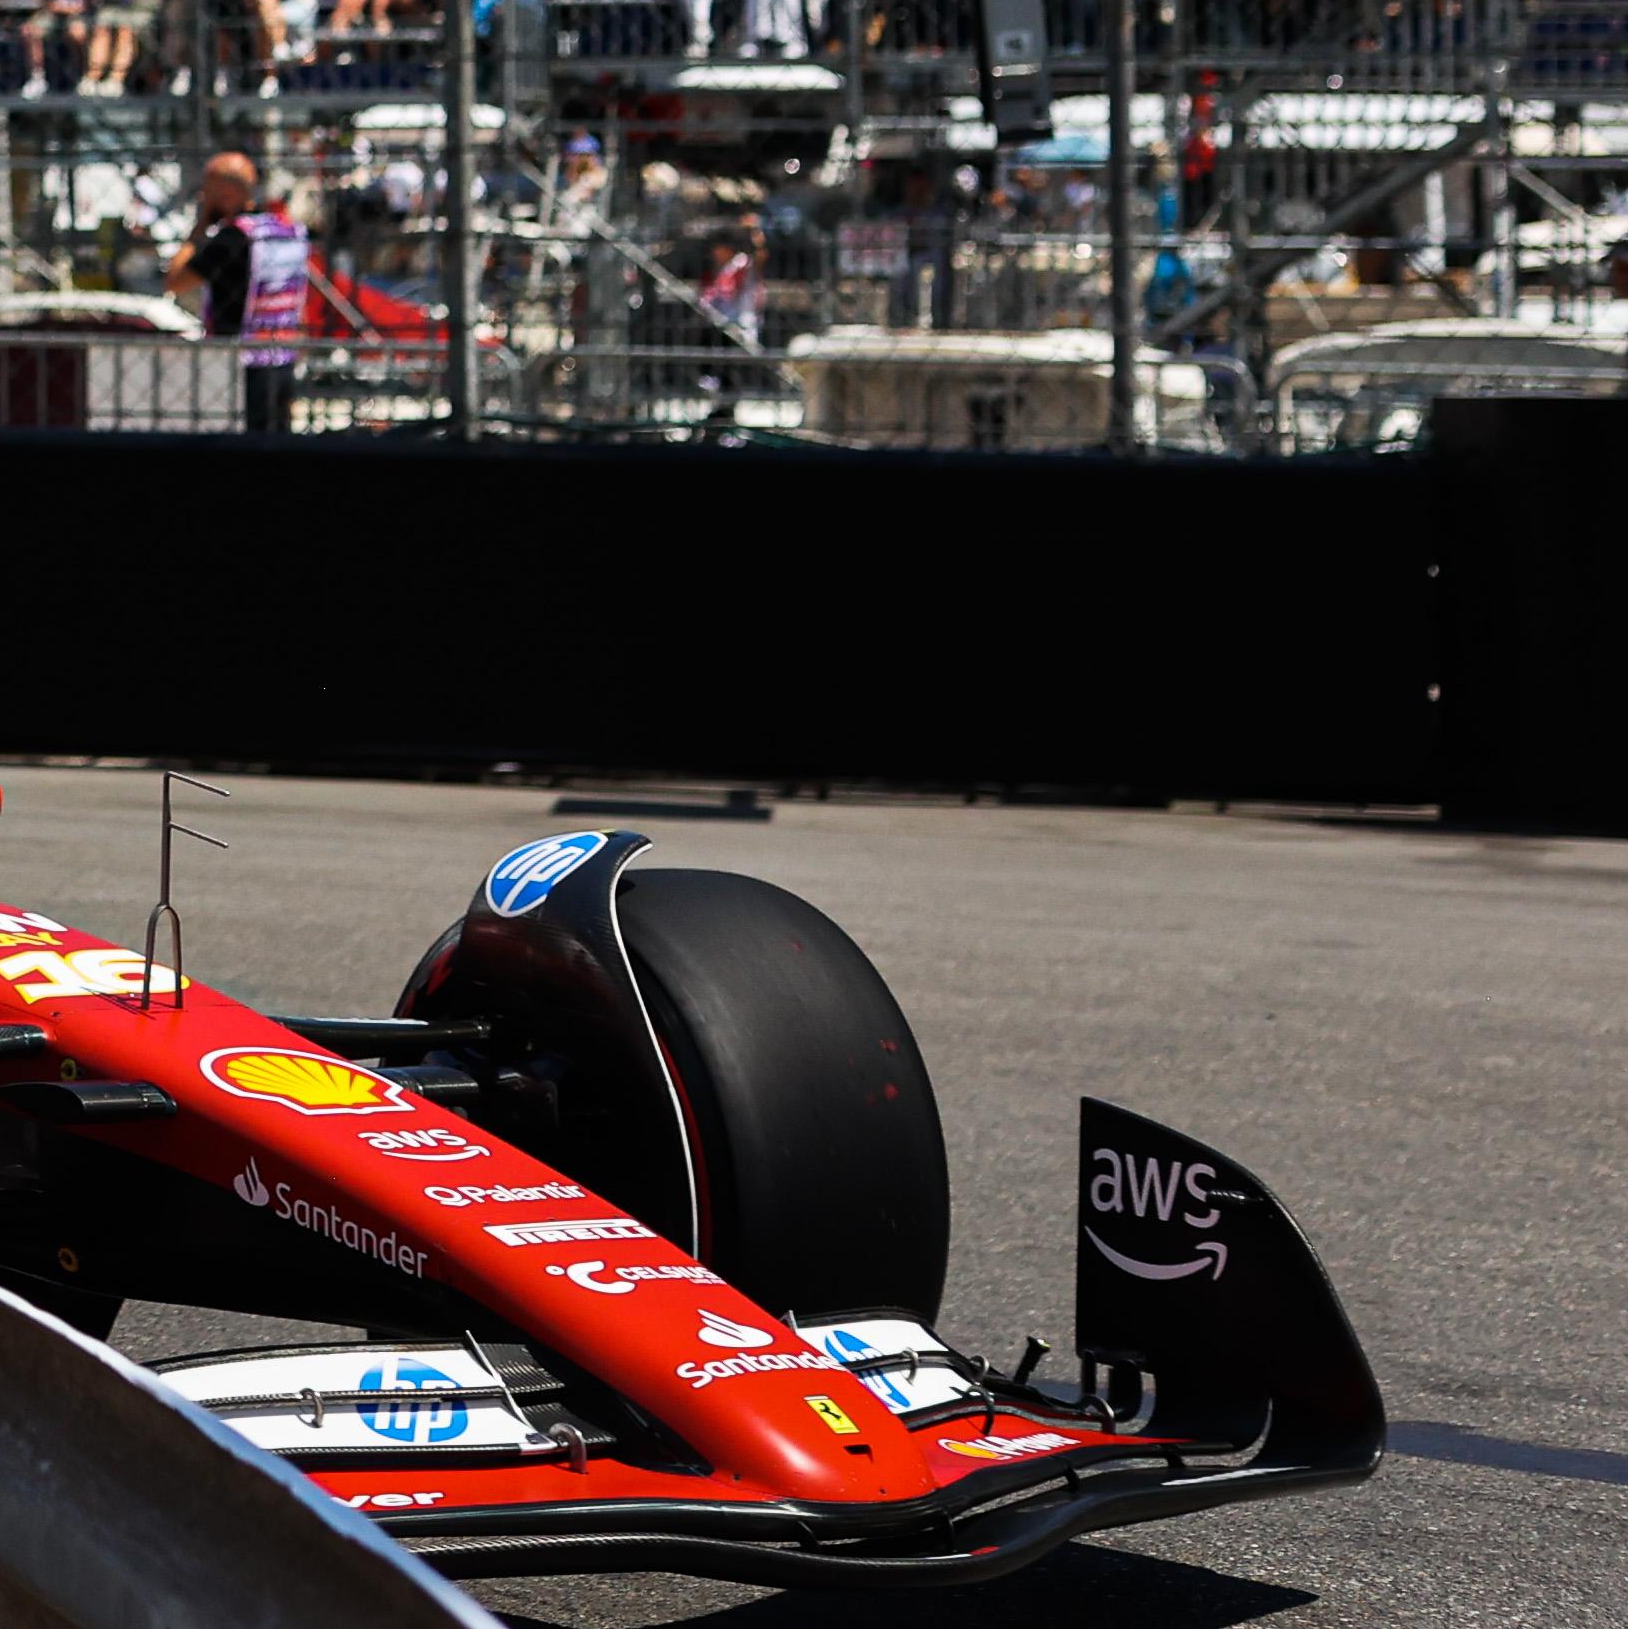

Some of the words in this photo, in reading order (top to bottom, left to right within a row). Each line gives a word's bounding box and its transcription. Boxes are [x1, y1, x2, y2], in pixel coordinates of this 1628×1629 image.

[493, 840, 589, 914] hp
[357, 1128, 469, 1150] aws
[457, 1181, 588, 1204] Palantir
[1091, 1148, 1221, 1229] aws
[274, 1182, 428, 1280] Santander
[483, 1218, 659, 1247] PIRELLI
[615, 1265, 721, 1281] CELSIUS
[676, 1351, 848, 1389] Santande
[368, 1357, 461, 1443] hp
